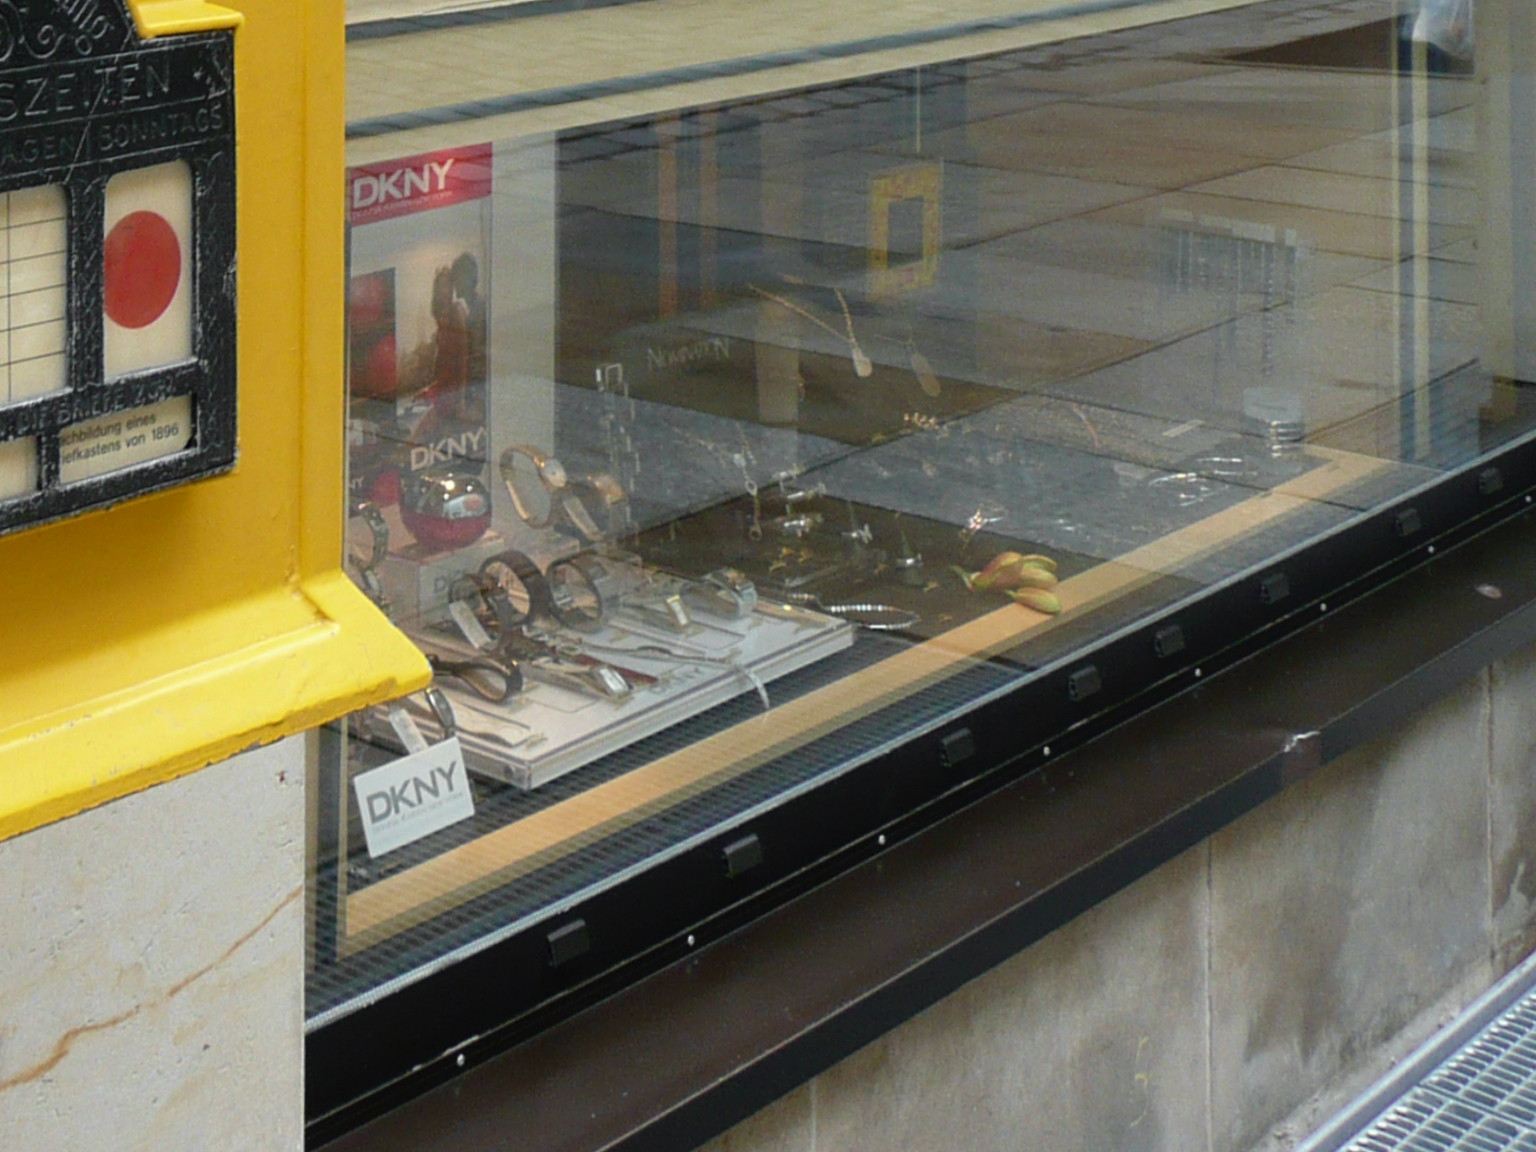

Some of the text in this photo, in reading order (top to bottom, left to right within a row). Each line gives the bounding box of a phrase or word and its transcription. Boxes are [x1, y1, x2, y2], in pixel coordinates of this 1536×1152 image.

[352, 158, 455, 209] DKNY
[124, 433, 147, 449] von
[151, 422, 179, 442] 1896
[125, 412, 157, 431] eines
[410, 426, 487, 471] DKNY
[366, 760, 457, 825] DKNY
